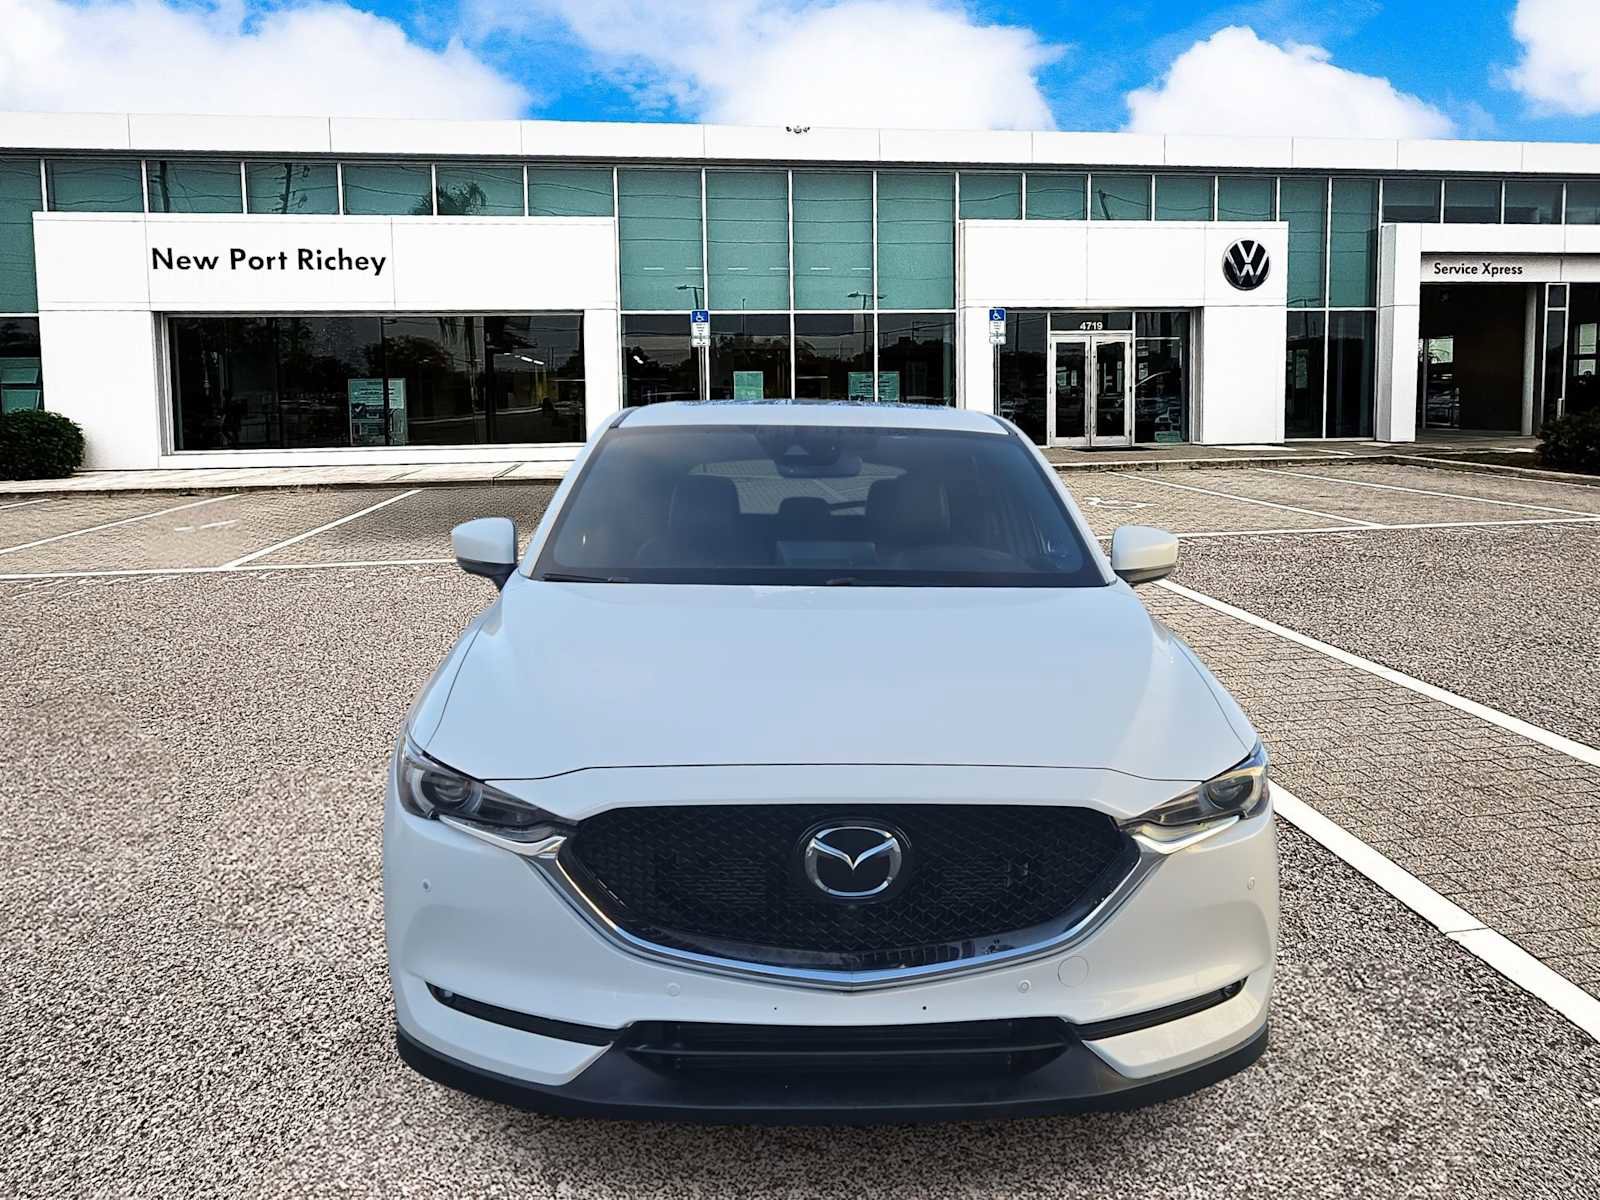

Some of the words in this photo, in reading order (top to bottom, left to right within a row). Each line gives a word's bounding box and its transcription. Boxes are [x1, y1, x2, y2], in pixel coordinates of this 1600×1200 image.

[151, 247, 219, 270] New
[230, 248, 288, 270] Port
[297, 247, 387, 276] Richey
[1433, 262, 1478, 275] Service
[1481, 262, 1523, 278] Xpress
[1079, 321, 1103, 330] 4719
